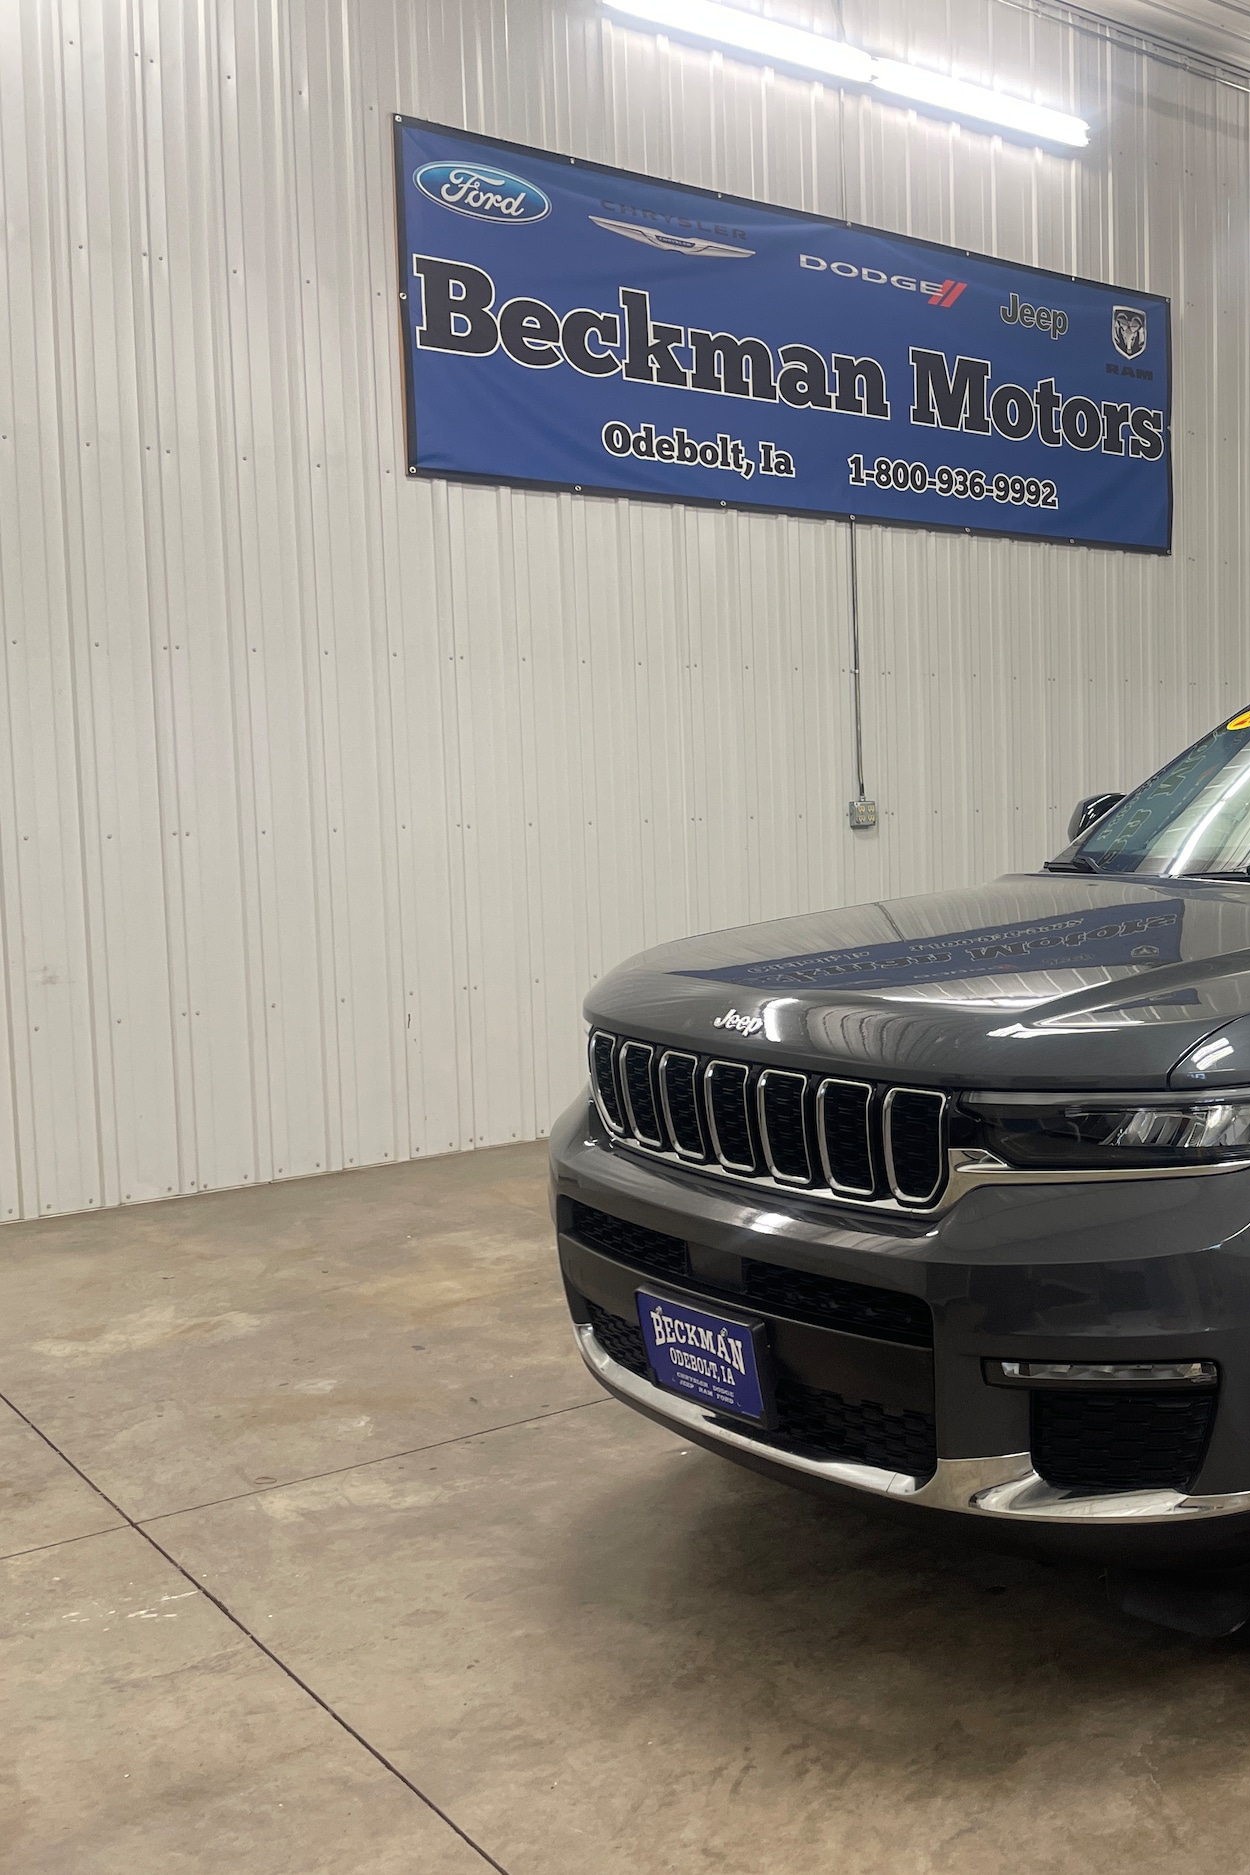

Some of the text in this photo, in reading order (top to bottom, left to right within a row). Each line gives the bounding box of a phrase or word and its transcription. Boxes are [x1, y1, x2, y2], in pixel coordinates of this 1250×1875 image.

[440, 166, 527, 218] Ford
[600, 200, 748, 240] CHRYSLER
[799, 253, 945, 297] DODGE
[1000, 292, 1069, 340] Jeep
[412, 252, 1164, 462] Beckman Motors
[1105, 363, 1153, 381] RAM
[601, 420, 796, 480] Odebolt, Ia
[847, 453, 1059, 510] 1-800-936-9992
[713, 1008, 763, 1037] Jeep
[650, 1310, 746, 1375] BECKMAN
